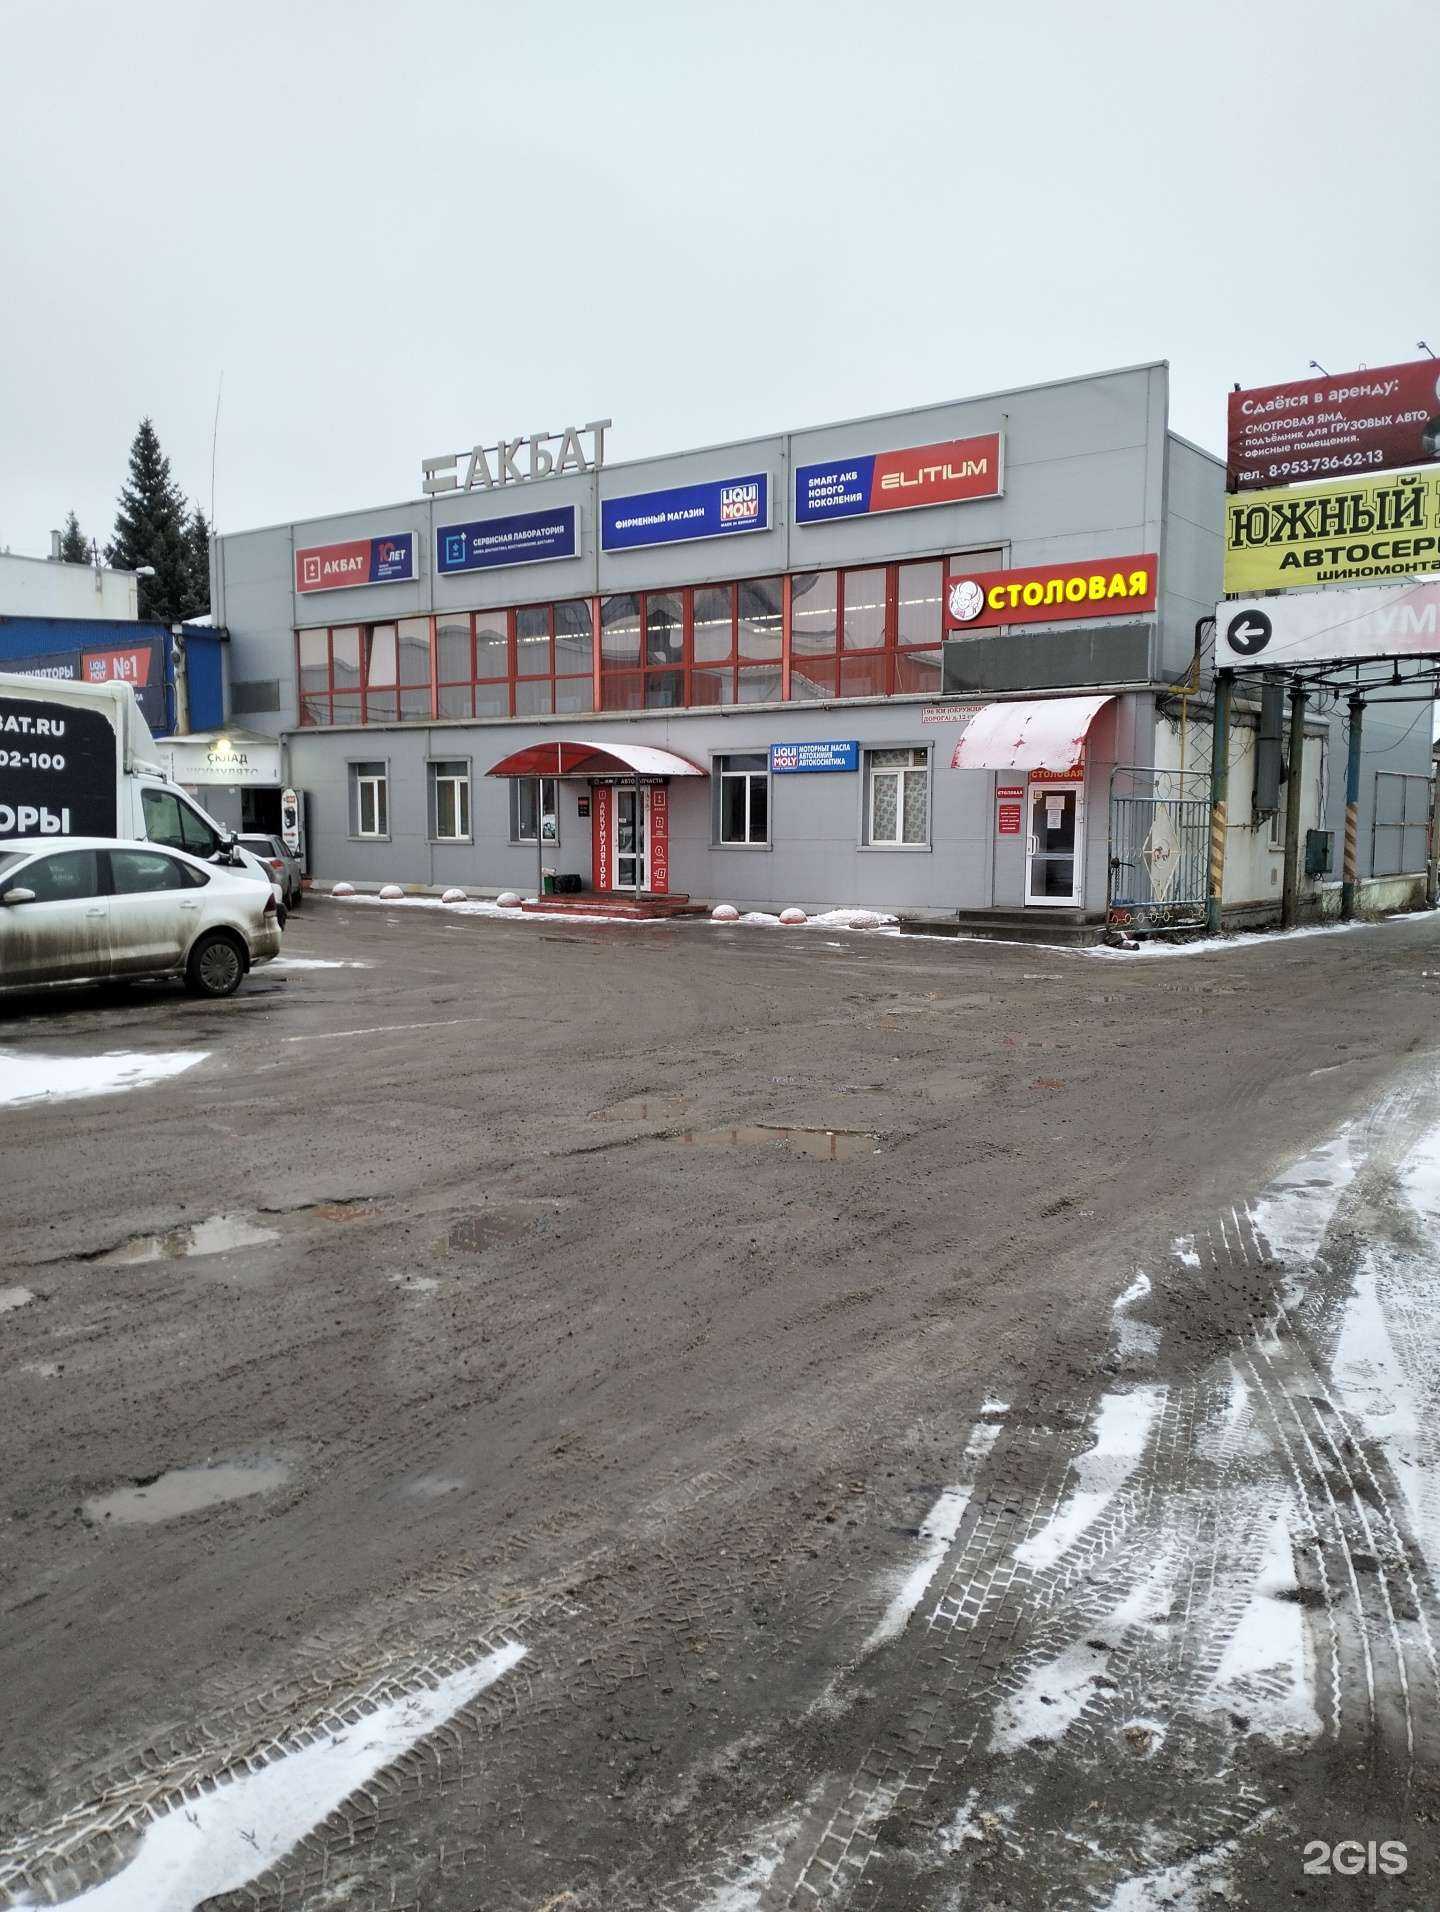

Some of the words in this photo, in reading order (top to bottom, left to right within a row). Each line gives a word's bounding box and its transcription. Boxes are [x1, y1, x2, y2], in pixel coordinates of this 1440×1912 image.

[1241, 393, 1309, 416] Сдаётся
[1314, 392, 1324, 404] в
[1328, 378, 1400, 404] аренду:
[1245, 415, 1314, 435] СМОТРОВАЯ
[1317, 411, 1347, 424] ЯМА,
[1245, 431, 1304, 447] подъёмник
[1306, 427, 1328, 440] для
[1330, 415, 1393, 433] ГРУЗОВЫХ
[1395, 409, 1431, 424] АВТО,
[463, 418, 612, 491] АКБАТ
[1244, 444, 1291, 459] офисные
[1293, 434, 1360, 451] помещения.
[881, 458, 988, 490] ELITIUM
[1238, 468, 1265, 482] тел.
[1268, 449, 1384, 478] 8-953-736-62-13
[808, 474, 838, 487] SMART
[839, 471, 858, 482] АКБ
[721, 485, 757, 504] LIQUI
[808, 485, 844, 498] НОВОГО
[808, 493, 863, 509] ПОКОЛЕНИЯ
[615, 512, 667, 530] ФИРМЕННЫЙ
[667, 507, 705, 521] МАГАЗИН
[722, 501, 758, 519] MOLY
[1230, 475, 1427, 549] ЮЖНЫЙ
[472, 532, 513, 547] СЕРВИСНАЯ
[513, 525, 565, 541] ЛАБОРАТОРИЯ
[389, 549, 406, 562] ЛЕТ
[1278, 536, 1440, 571] АВТОСЕР
[323, 556, 364, 575] АКБАТ
[987, 569, 1149, 610] СТОЛОВАЯ
[773, 746, 797, 757] LIQUI
[830, 743, 851, 752] МАСЛА
[207, 753, 248, 765] СКЛАД
[773, 757, 798, 767] MOLY
[1031, 769, 1084, 779] СТОЛОВАЯ
[0, 803, 70, 834] ОРЫ
[599, 801, 607, 888] АККУМУЛЯТОРЫ
